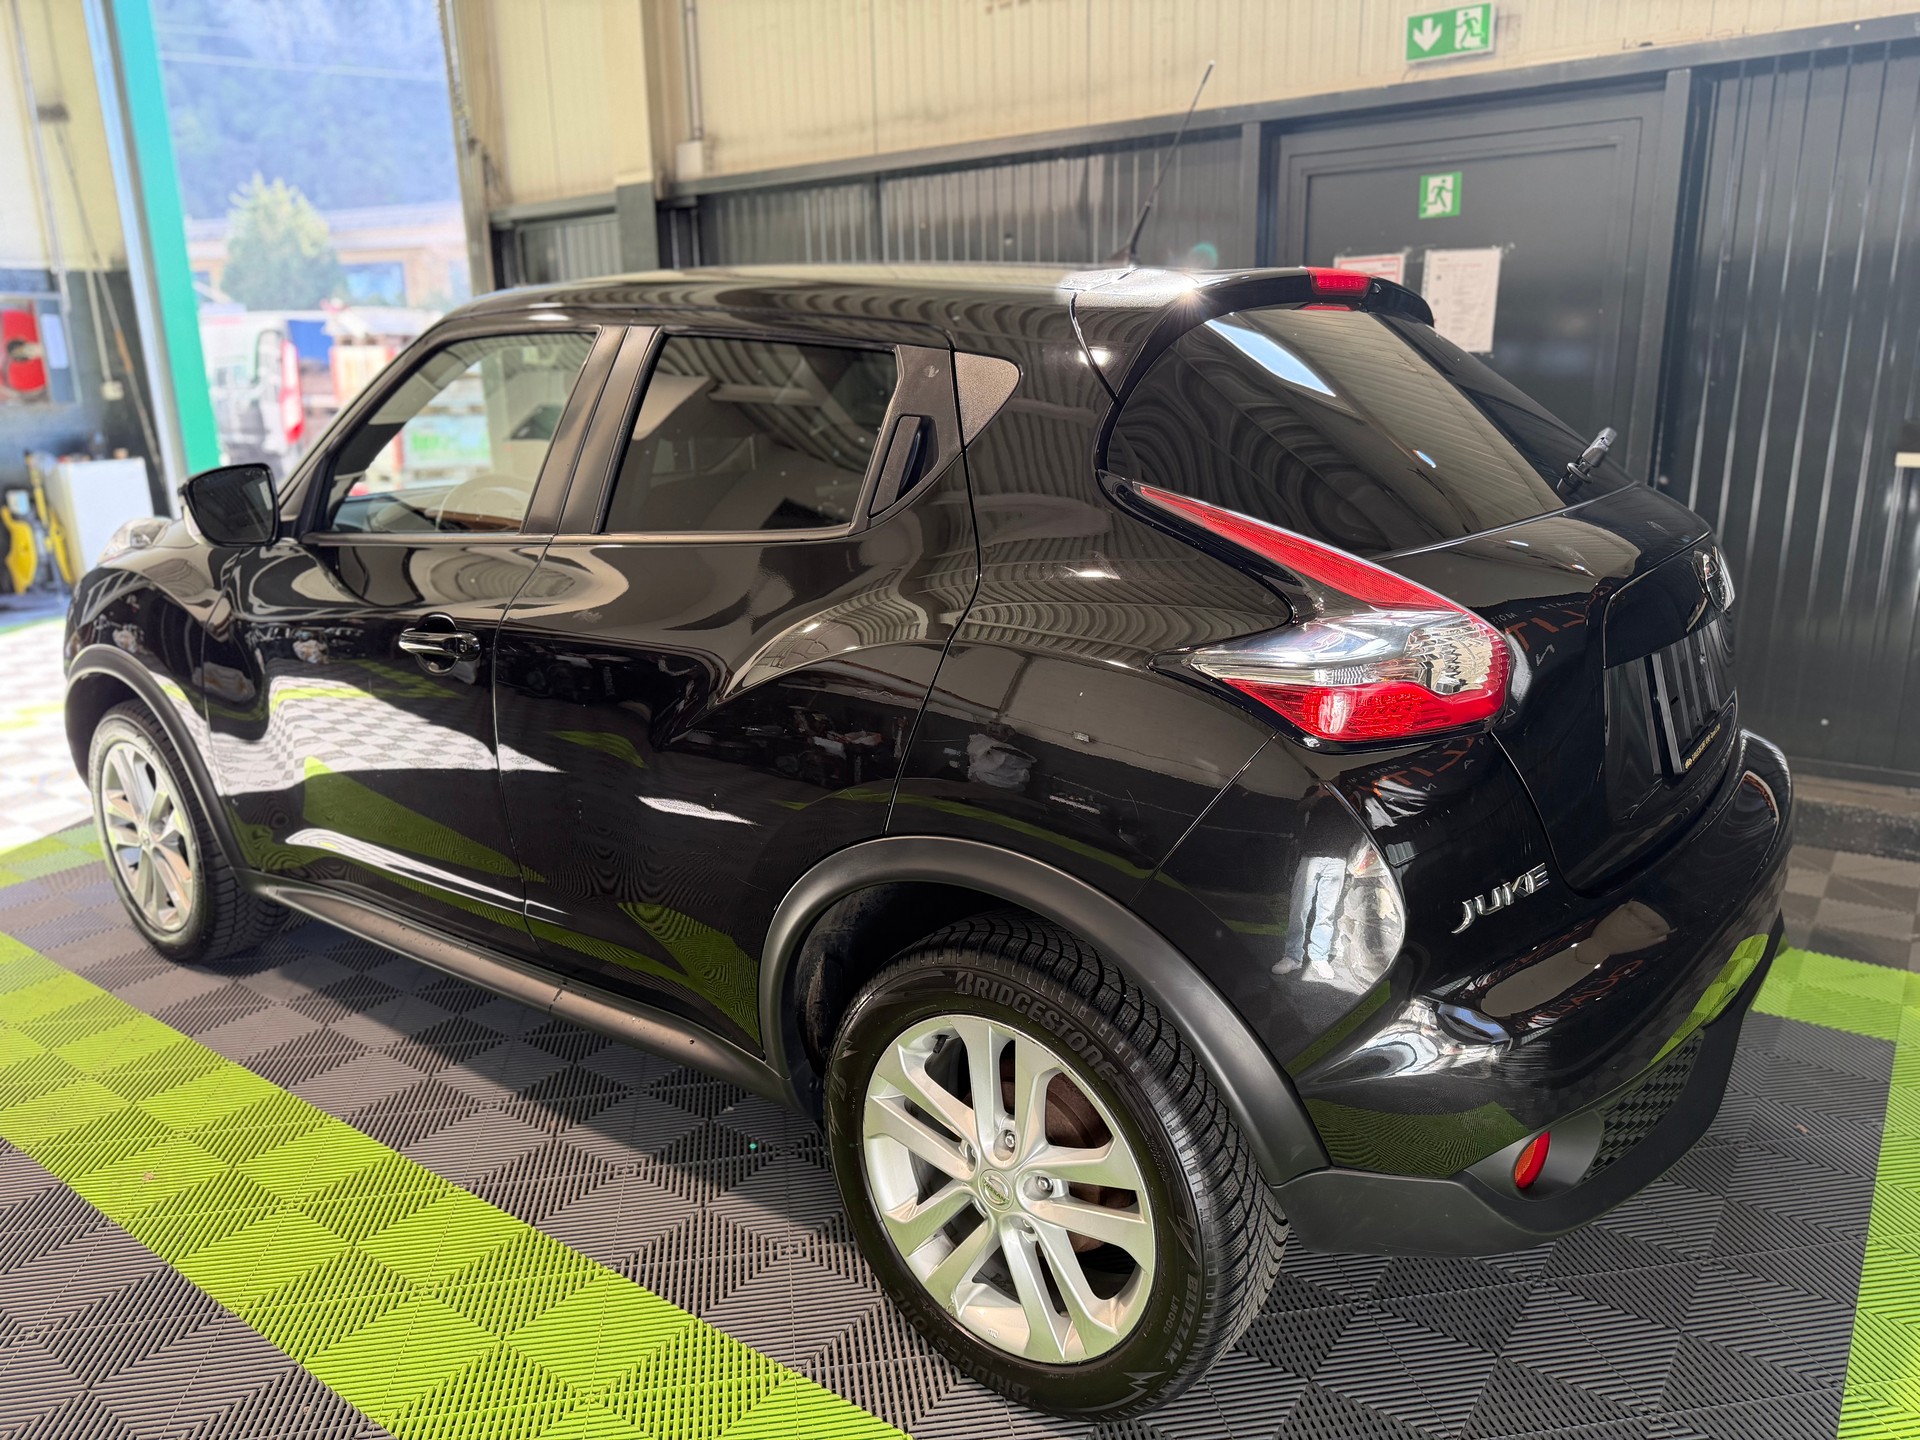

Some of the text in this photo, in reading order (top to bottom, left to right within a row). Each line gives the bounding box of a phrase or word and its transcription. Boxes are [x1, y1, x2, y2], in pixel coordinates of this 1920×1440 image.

[1451, 862, 1550, 934] JUKE
[954, 971, 1118, 1080] BRIDGESTONE
[1165, 1273, 1200, 1365] BLIZZAK
